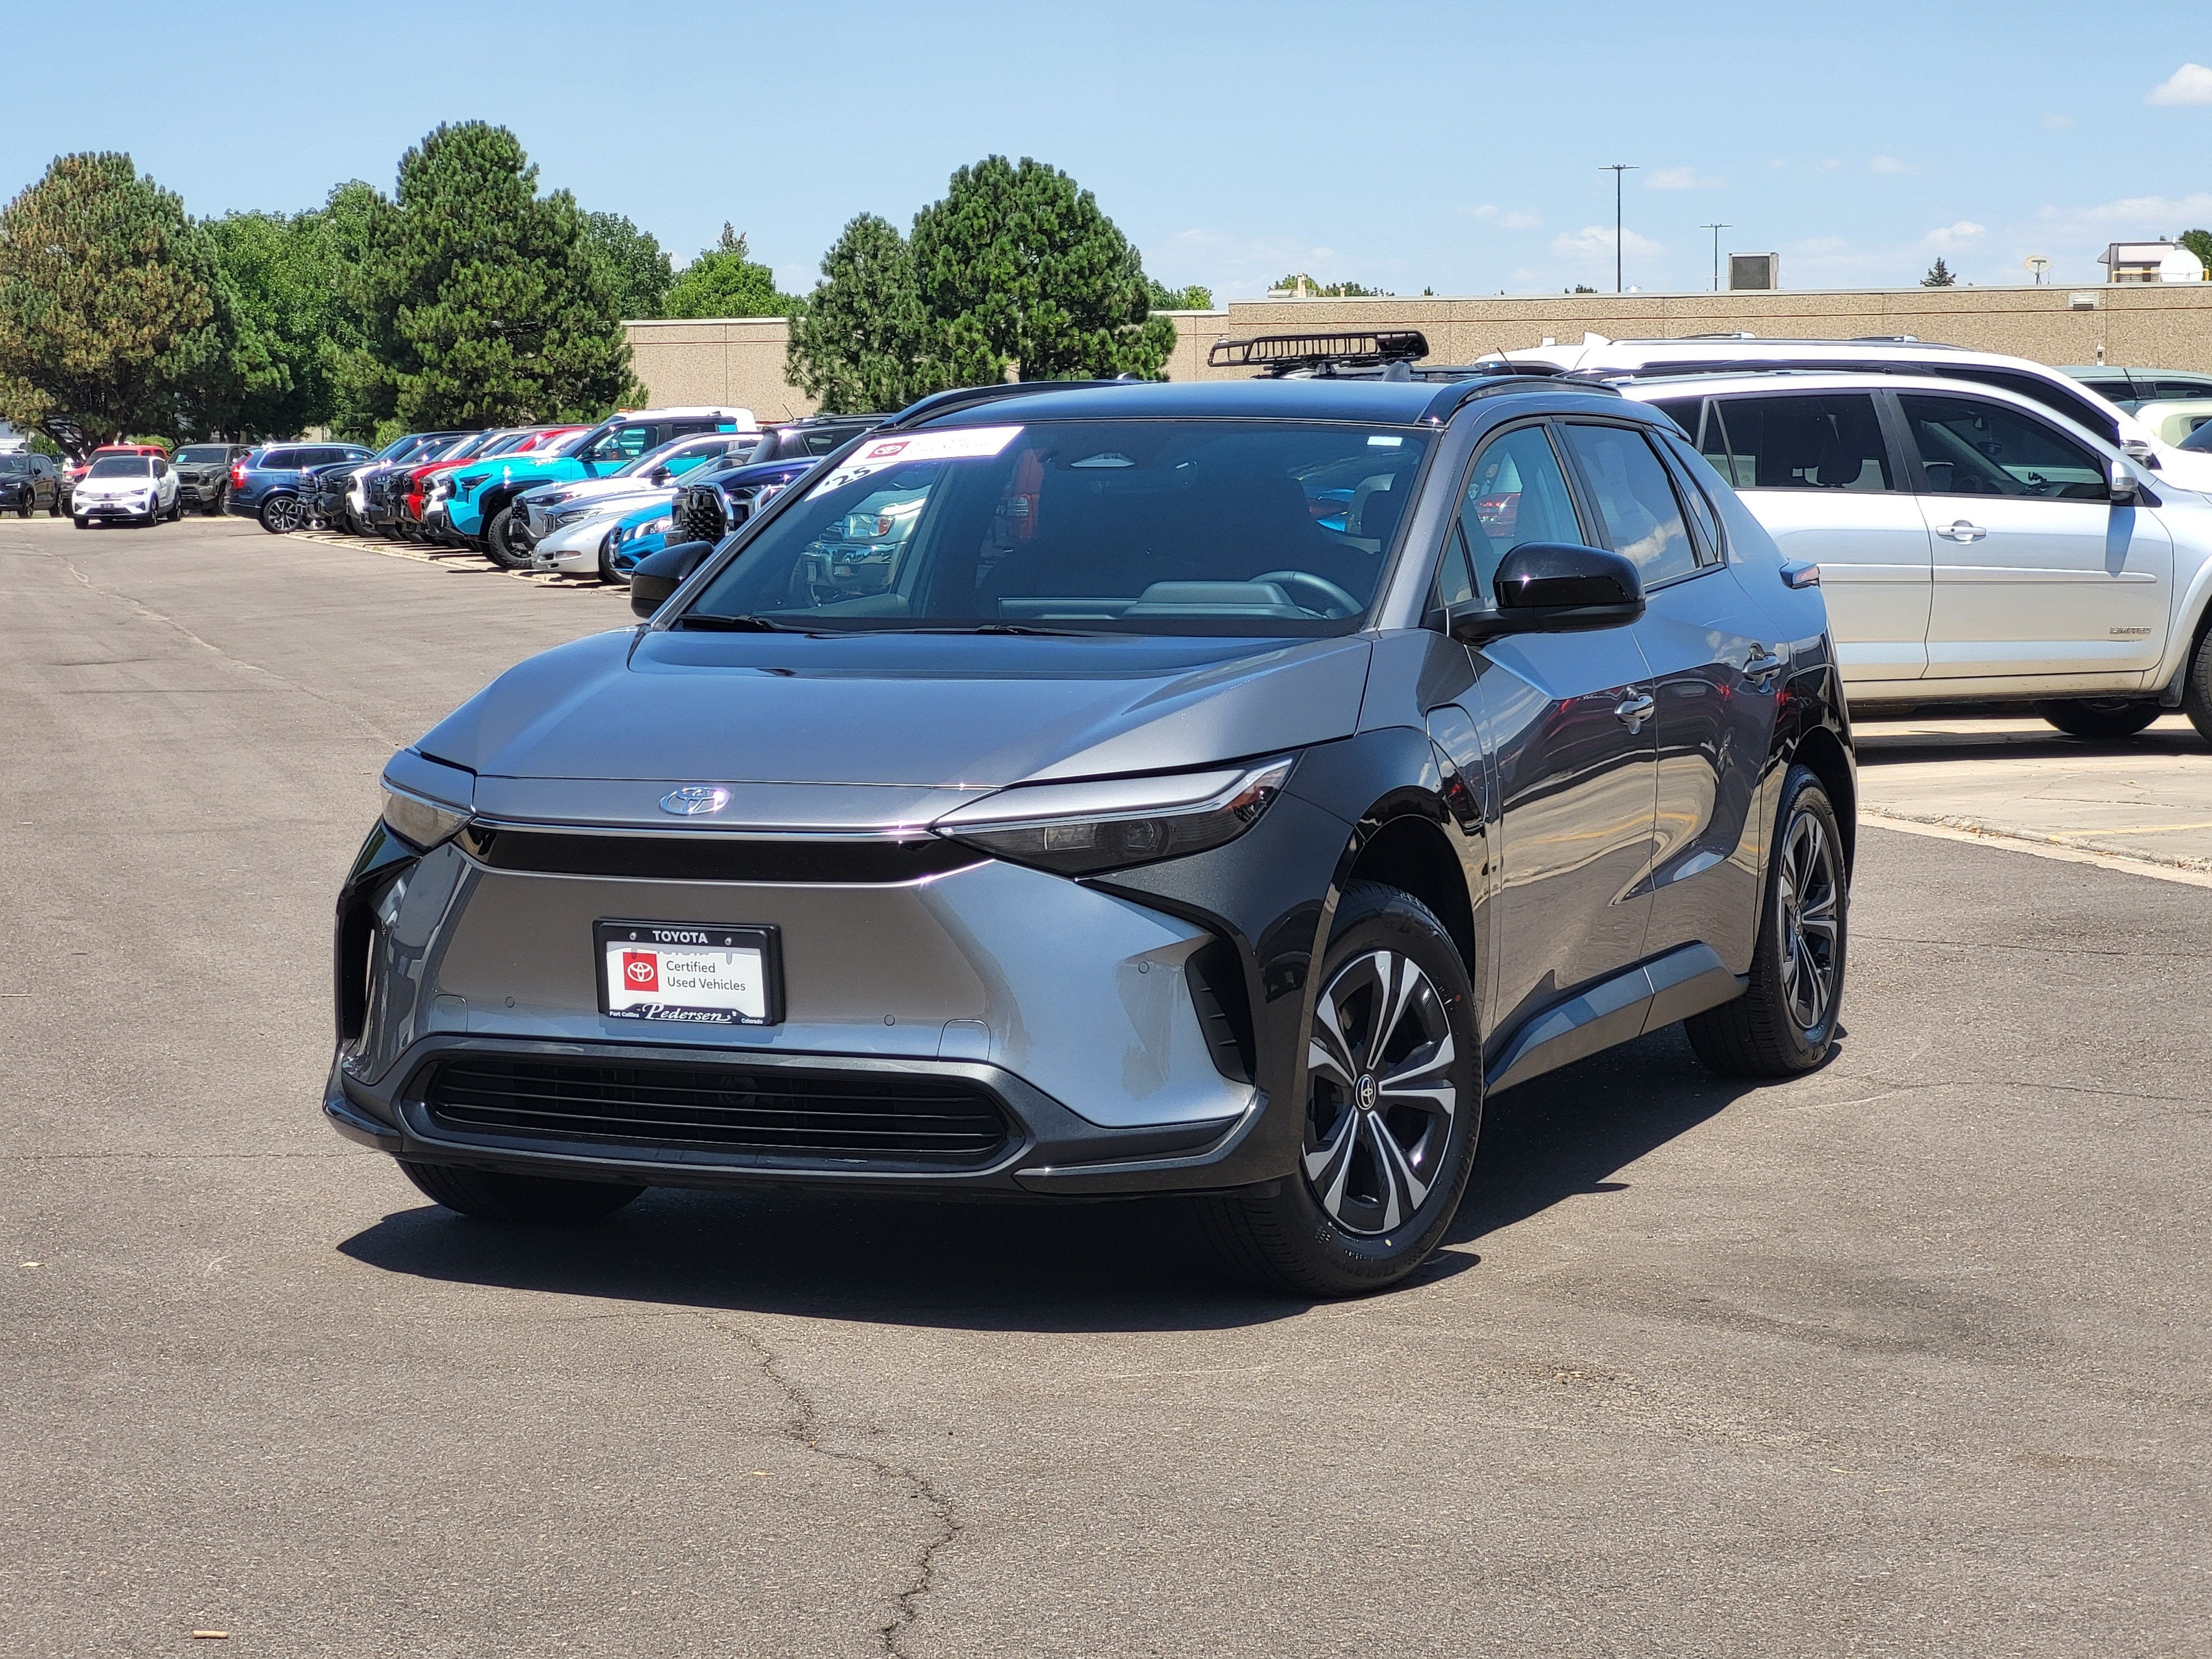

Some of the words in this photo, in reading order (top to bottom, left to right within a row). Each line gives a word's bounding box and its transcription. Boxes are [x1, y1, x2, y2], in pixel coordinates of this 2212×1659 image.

[652, 930, 708, 944] TOYOTA
[666, 960, 716, 973] Certified
[667, 976, 696, 988] Used
[698, 978, 746, 991] Vehicles
[642, 1003, 731, 1021] Pedersen
